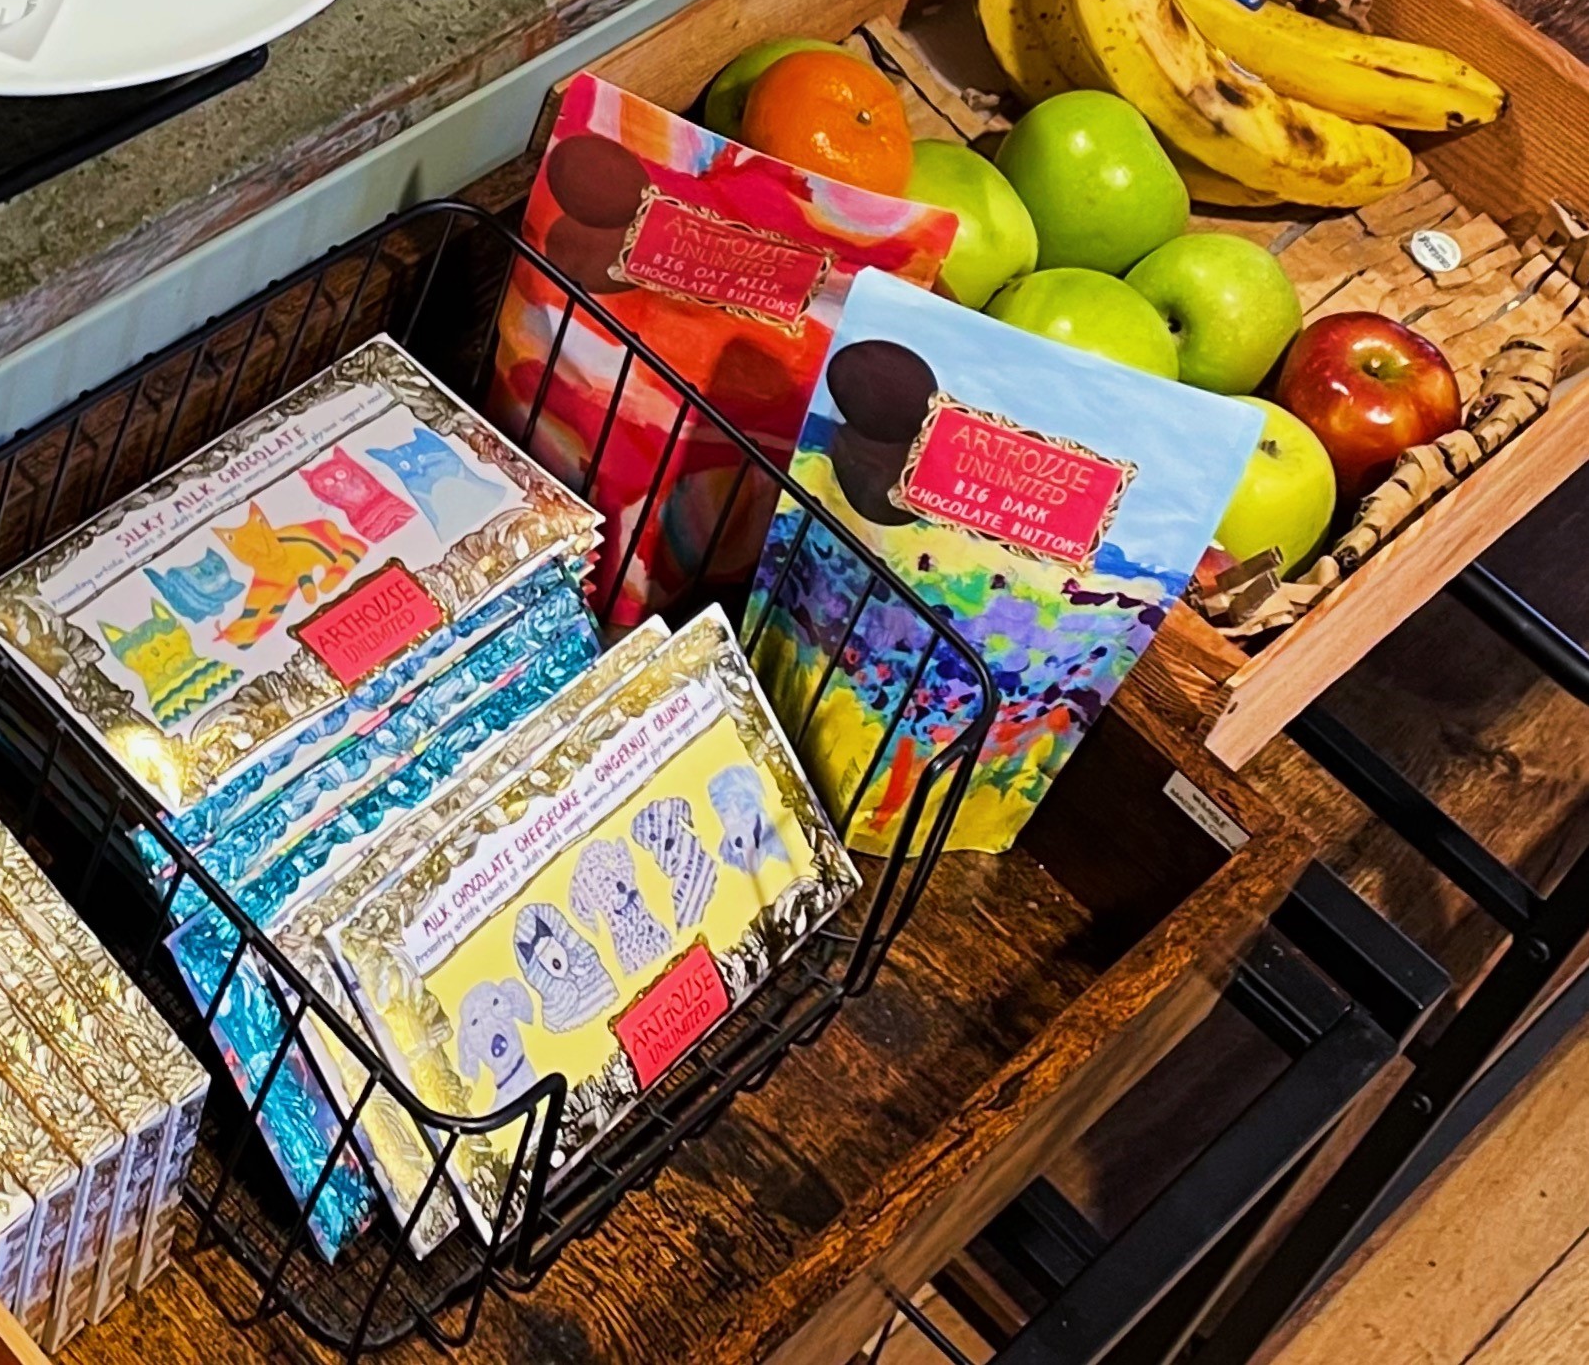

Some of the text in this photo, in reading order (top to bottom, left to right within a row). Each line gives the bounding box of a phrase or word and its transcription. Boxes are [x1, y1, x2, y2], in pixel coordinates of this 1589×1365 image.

[652, 251, 783, 295] BIG OAT MILK
[662, 215, 801, 270] ARTHOUSE
[672, 237, 776, 278] UNLIMITED
[629, 261, 797, 317] CHOCOLATE BUTTONS
[114, 422, 308, 550] SILKY MILK CHOCOLATE
[949, 422, 1095, 494] ARTHOUSE
[955, 451, 1069, 508] UNLIMITED
[906, 484, 1086, 558] CHOCOLATE BUTTONS
[952, 478, 1051, 525] BIG DARK
[312, 577, 418, 655] ARTHOUSE
[341, 606, 416, 663] UNLIMITED
[418, 902, 454, 937] MILK
[448, 845, 518, 910] CHOCOLATE
[510, 787, 584, 855] CHEESECAKE
[590, 723, 655, 785] GINGERNUT
[649, 690, 695, 733] CRUNCH
[632, 961, 716, 1055] ARTHOUSE
[647, 998, 712, 1065] UNLIMITED
